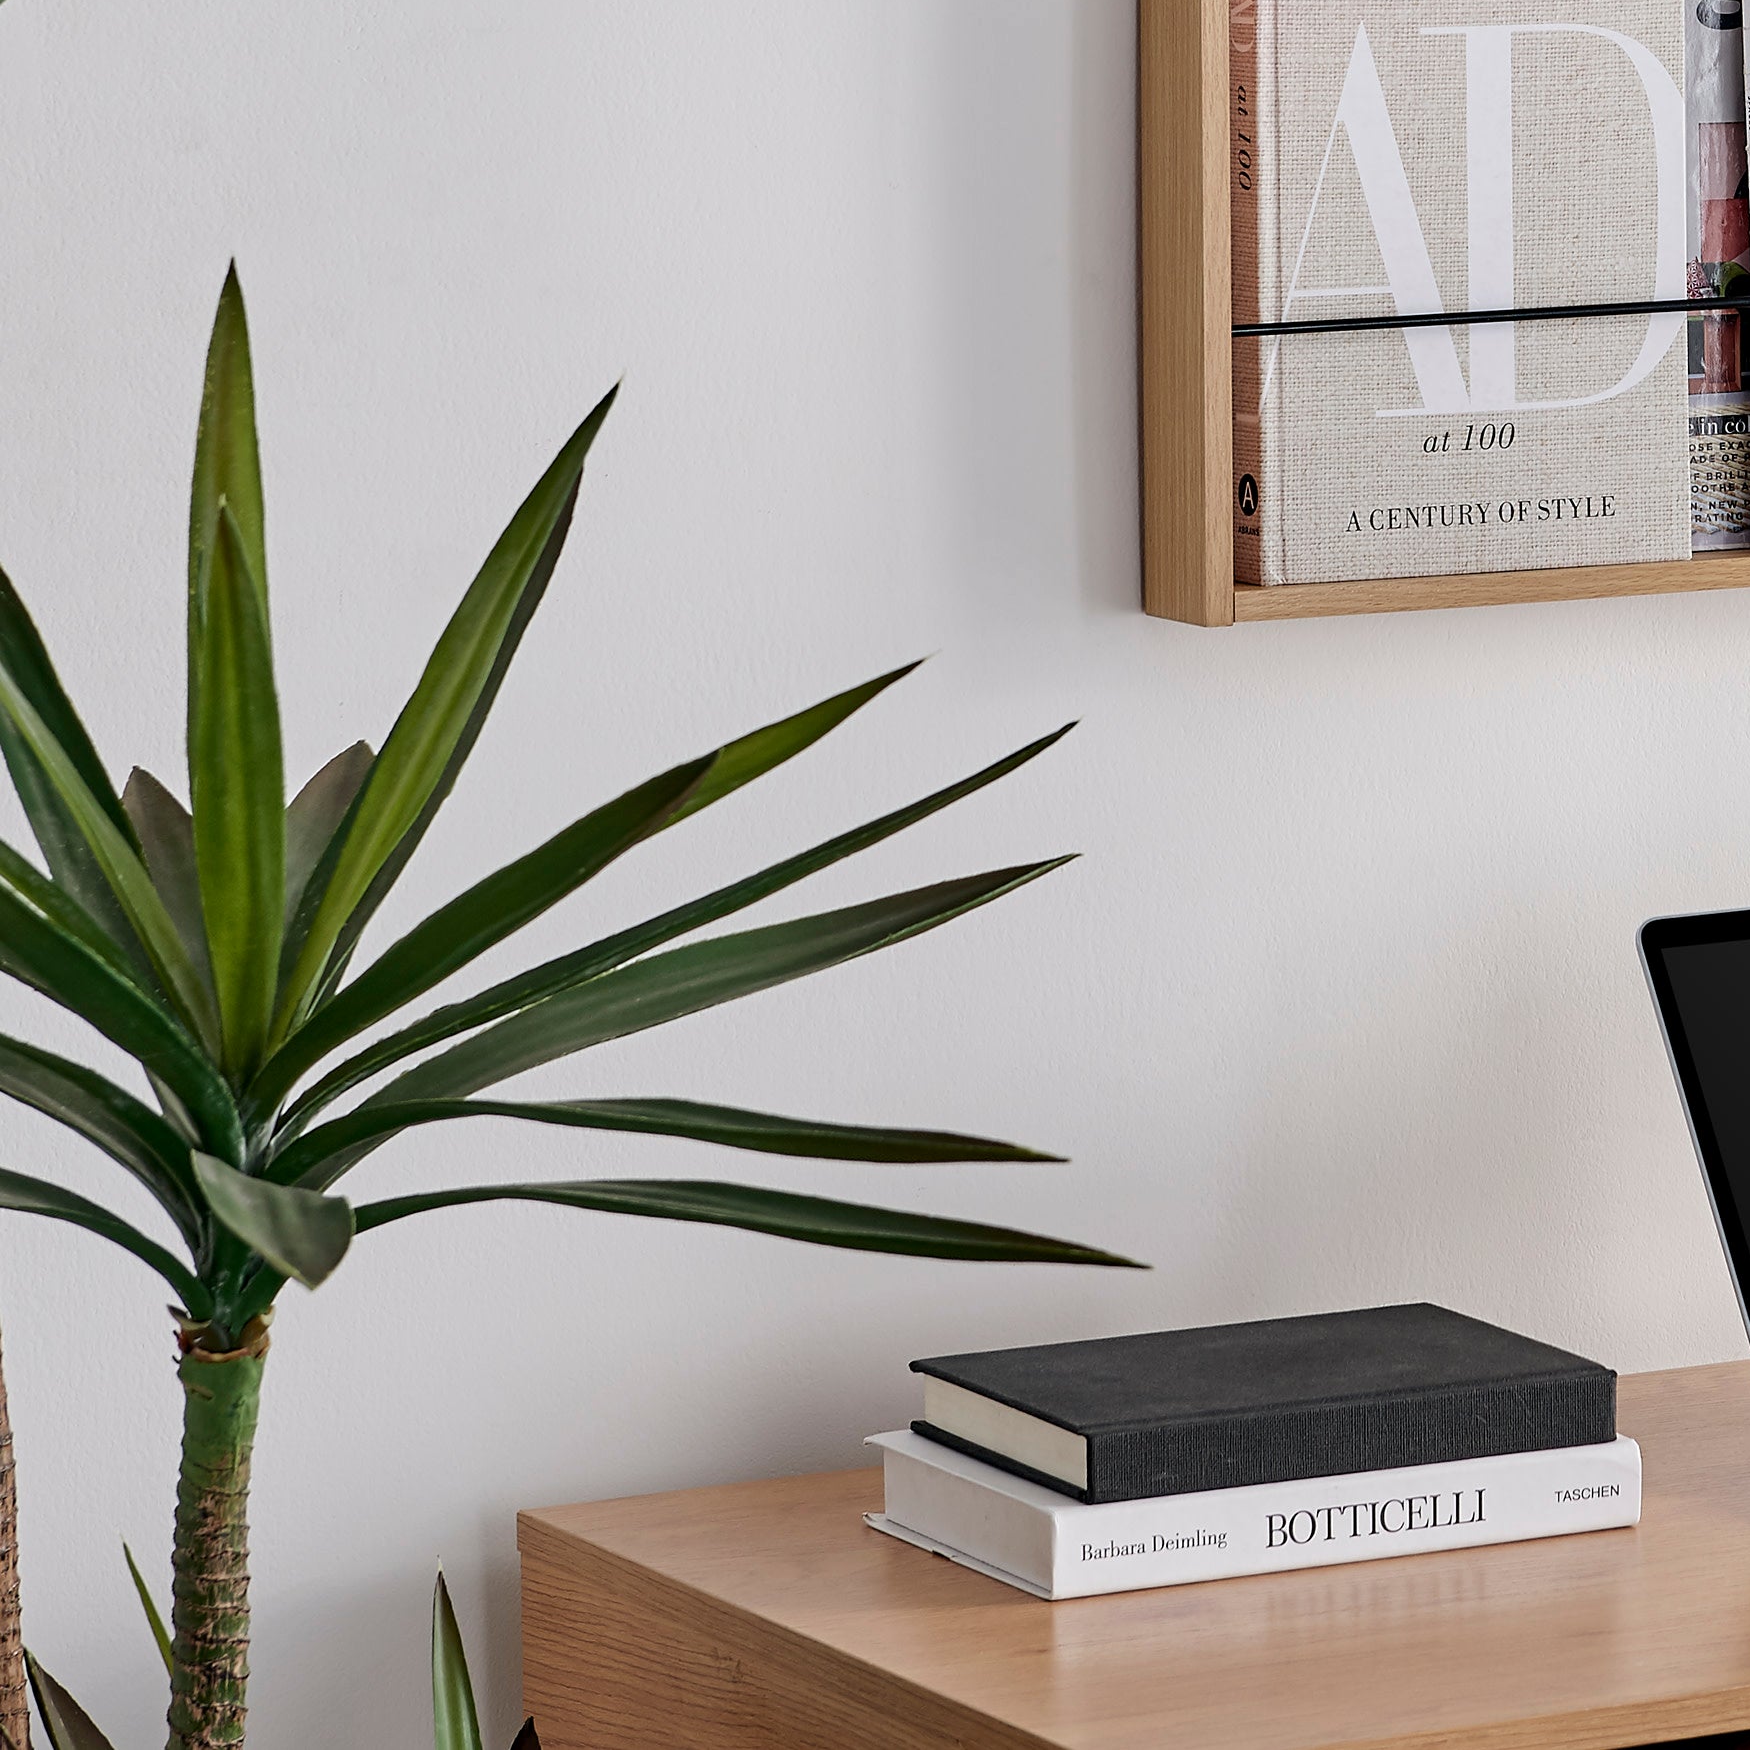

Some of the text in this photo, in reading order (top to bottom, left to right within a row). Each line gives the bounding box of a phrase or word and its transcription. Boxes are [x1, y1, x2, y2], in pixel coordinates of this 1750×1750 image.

[1237, 85, 1252, 191] at 100
[1260, 20, 1687, 417] AD
[1422, 422, 1516, 454] at 100
[1701, 418, 1719, 435] in
[1721, 453, 1739, 463] OF
[1344, 495, 1616, 533] A CENTURY OF STYLE
[1708, 500, 1738, 510] NEW
[1080, 1483, 1622, 1562] Barbara Deimling BOTTICELLI TASCHEN
